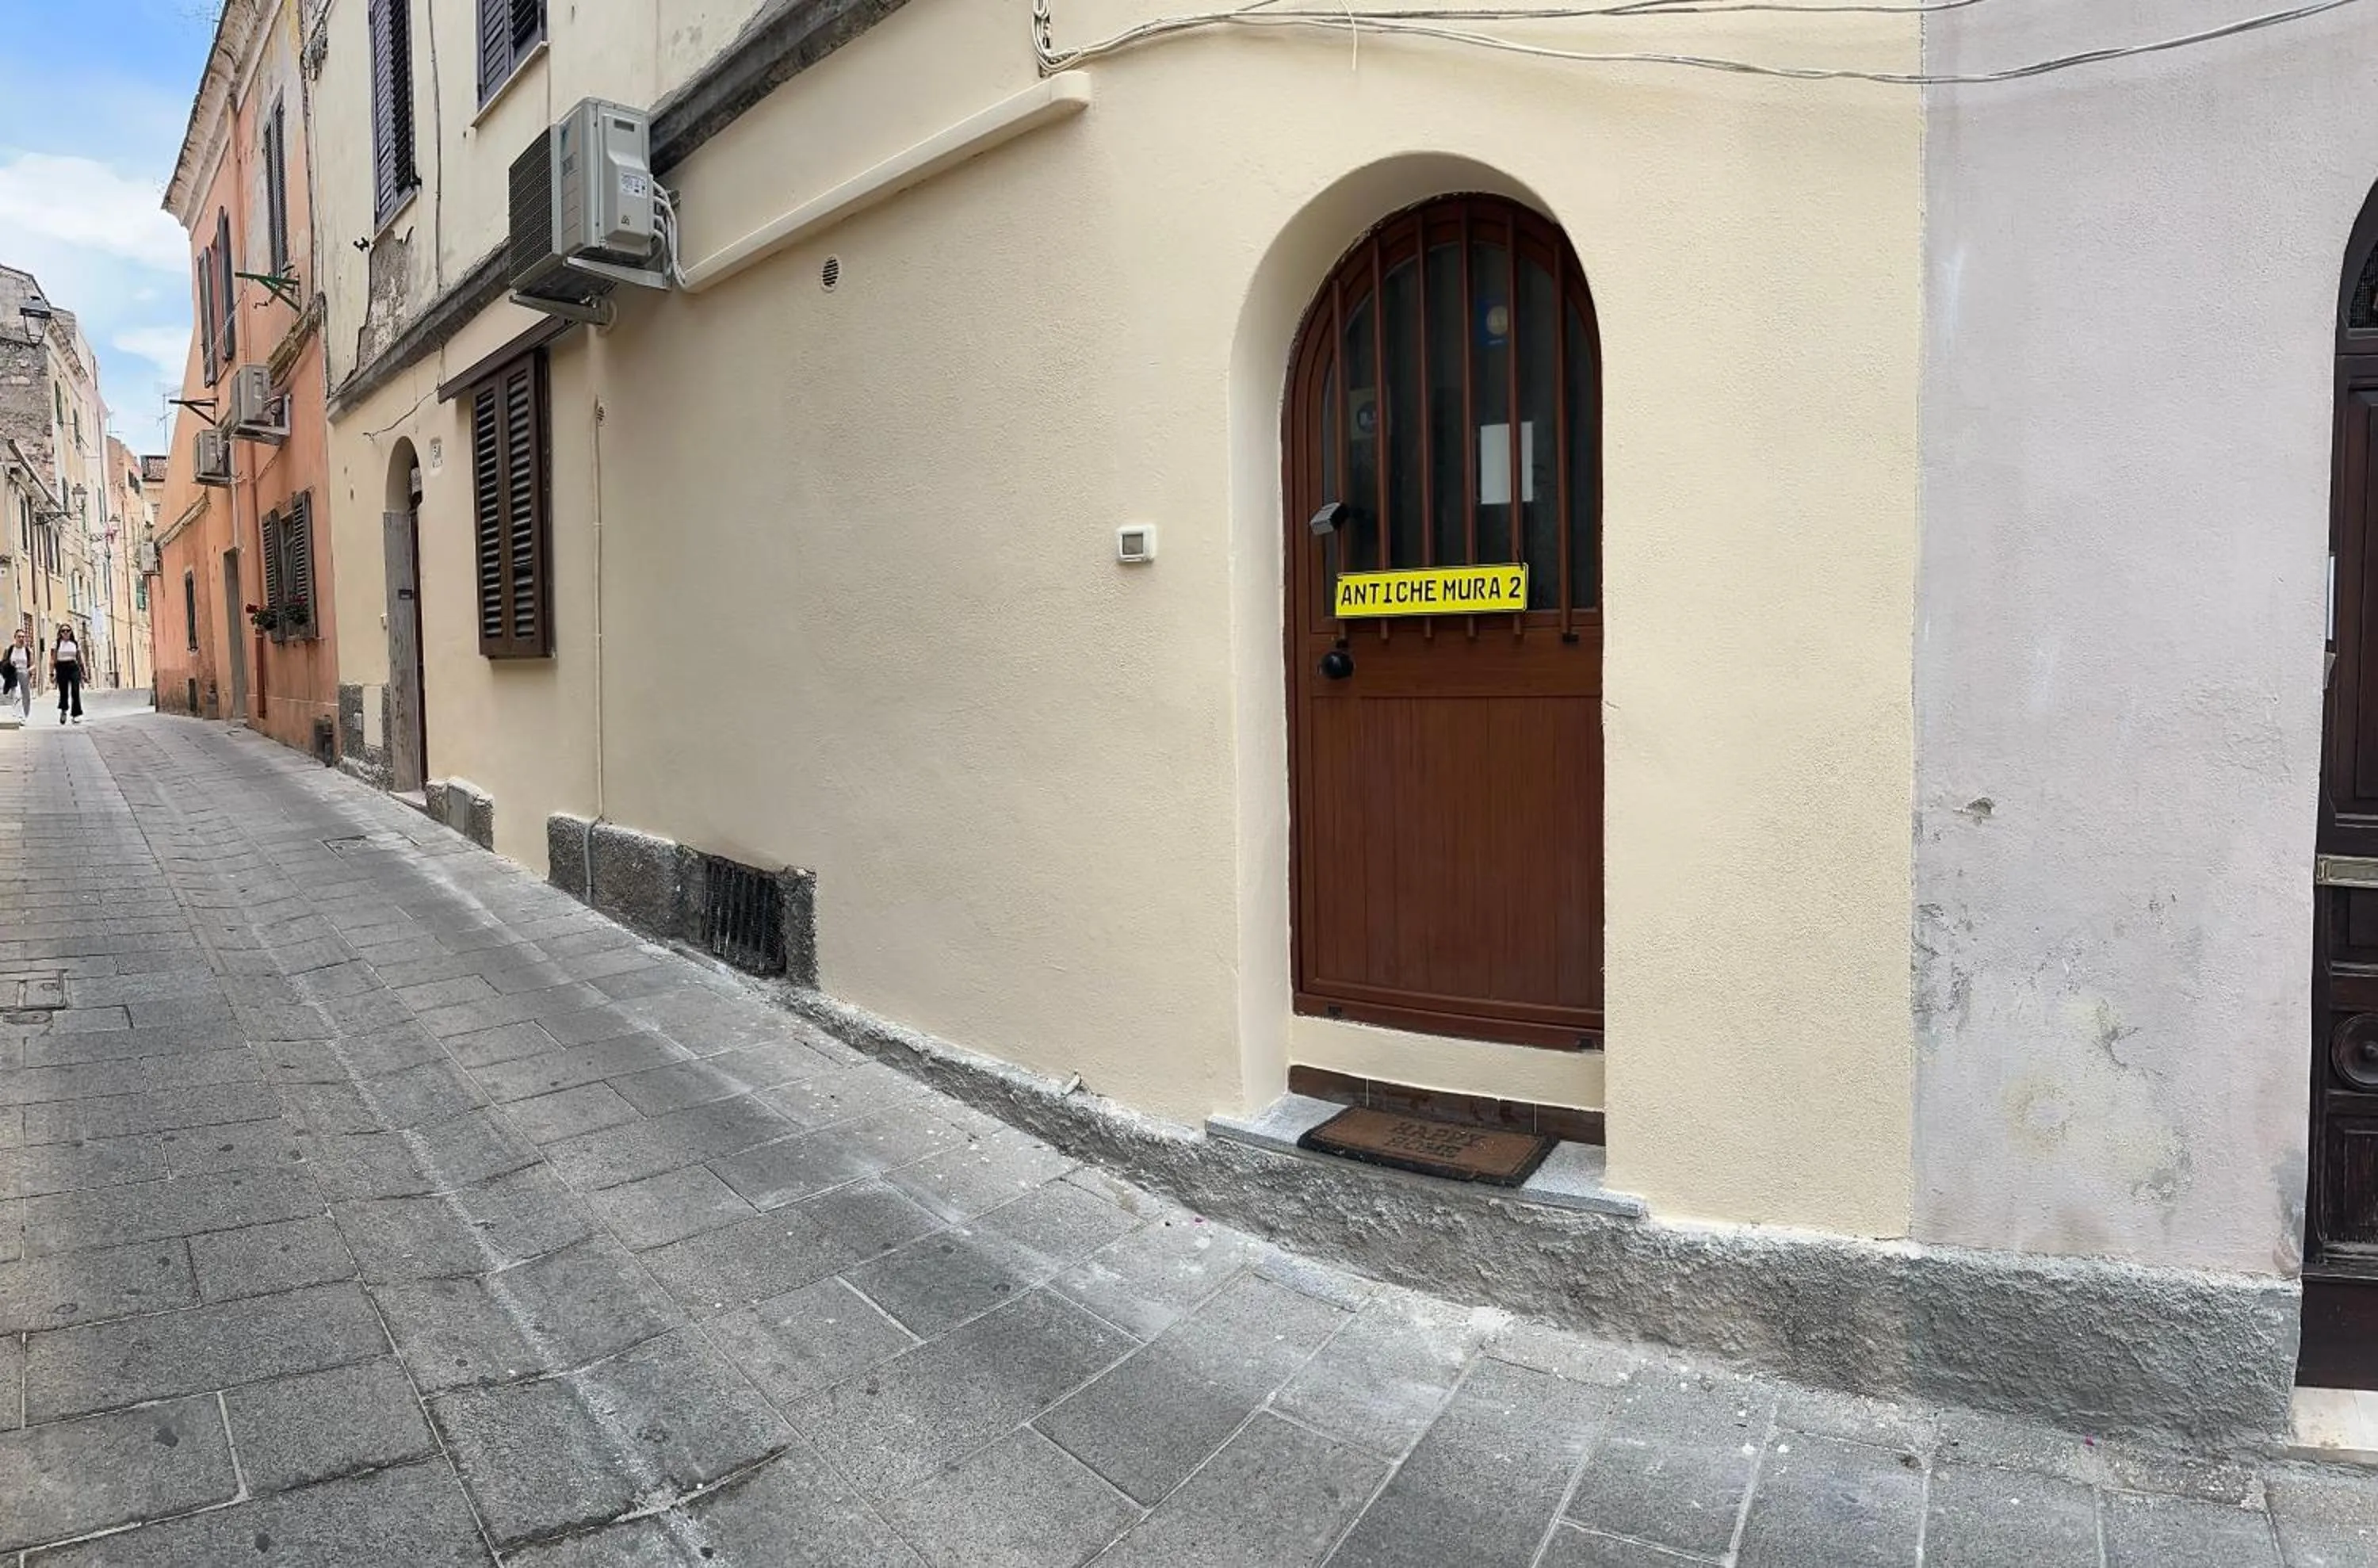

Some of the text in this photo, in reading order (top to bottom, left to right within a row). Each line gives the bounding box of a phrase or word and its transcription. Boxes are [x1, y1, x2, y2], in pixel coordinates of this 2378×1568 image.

[1340, 576, 1521, 606] ANTICHE MURA 2
